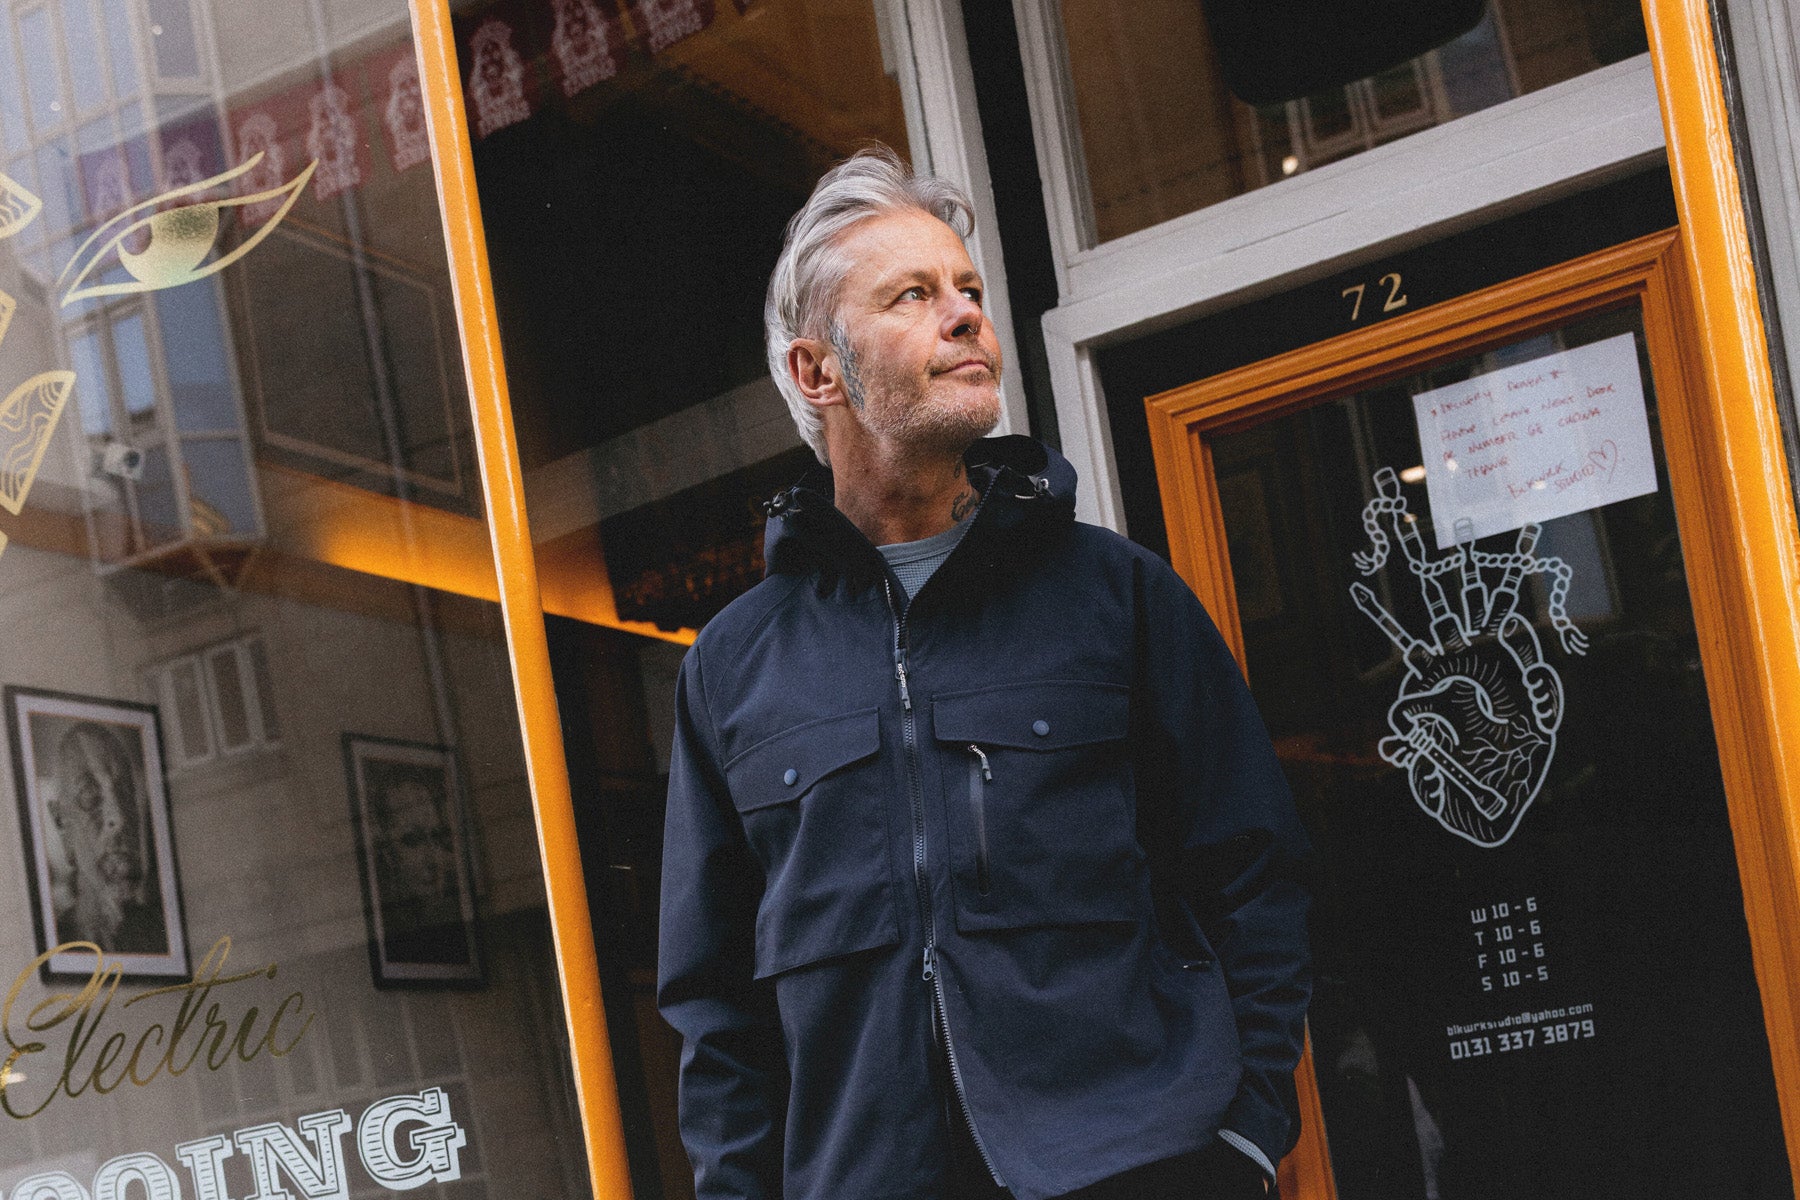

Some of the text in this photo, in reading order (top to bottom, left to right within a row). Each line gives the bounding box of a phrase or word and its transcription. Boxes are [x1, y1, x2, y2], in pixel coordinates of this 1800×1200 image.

[1342, 272, 1408, 321] 72
[1470, 908, 1487, 924] W
[1474, 931, 1484, 946] T
[1478, 954, 1488, 969] F
[1481, 976, 1492, 992] S
[1, 936, 315, 1119] Electric
[1450, 1019, 1596, 1060] 0131 337 3879
